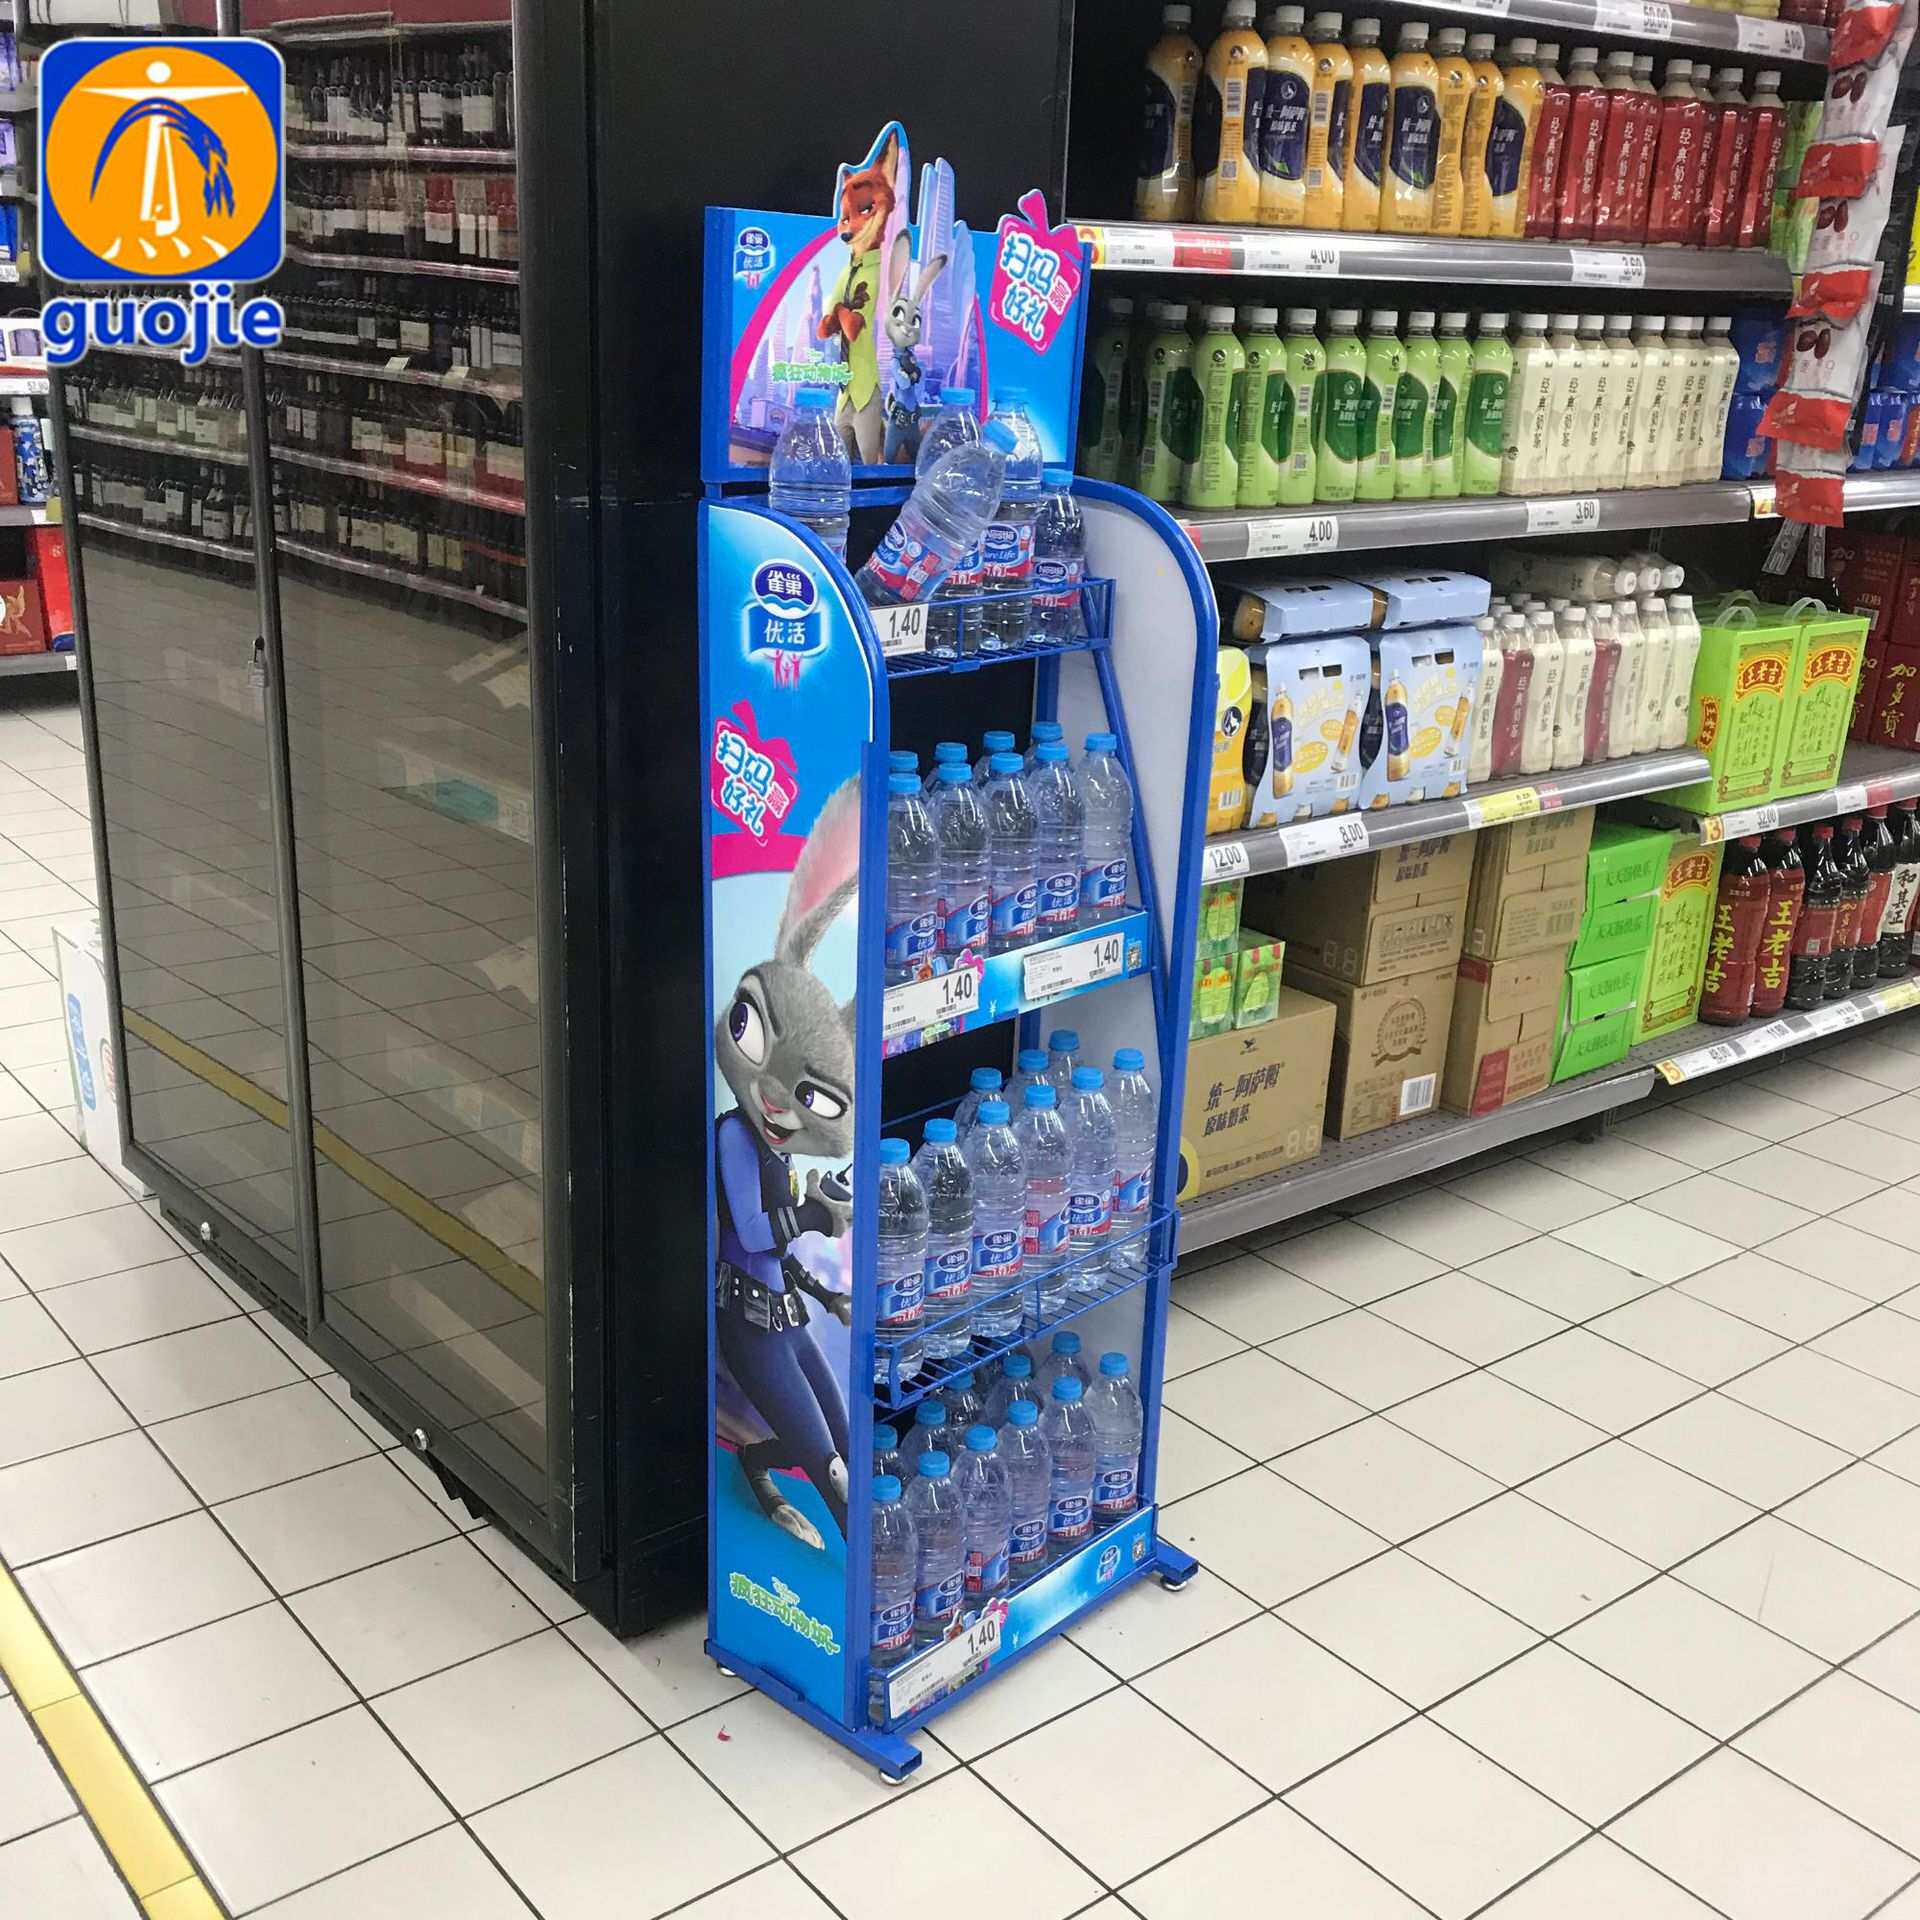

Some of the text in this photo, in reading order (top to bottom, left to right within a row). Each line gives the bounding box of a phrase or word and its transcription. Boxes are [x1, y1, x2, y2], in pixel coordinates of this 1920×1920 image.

[1001, 233, 1059, 298] 扫码
[1003, 283, 1047, 338] 好礼
[1575, 501, 1595, 520] 3.60
[1308, 520, 1333, 542] 4.00
[767, 570, 803, 596] 雀巢
[764, 618, 806, 645] 优活
[888, 607, 921, 639] 1.40
[1743, 661, 1779, 690] 王老吉
[1812, 652, 1849, 676] 王老吉
[717, 732, 773, 799] 扫码
[722, 778, 766, 836] 好礼
[1756, 809, 1777, 825] 32.00
[1340, 822, 1364, 843] 8.00
[1209, 844, 1242, 869] 12.00
[1094, 938, 1119, 968] 1.40
[1704, 904, 1736, 993] 王老吉
[1761, 900, 1793, 989] 王老吉
[942, 973, 972, 1005] 1.40
[967, 1619, 996, 1655] 1.40
